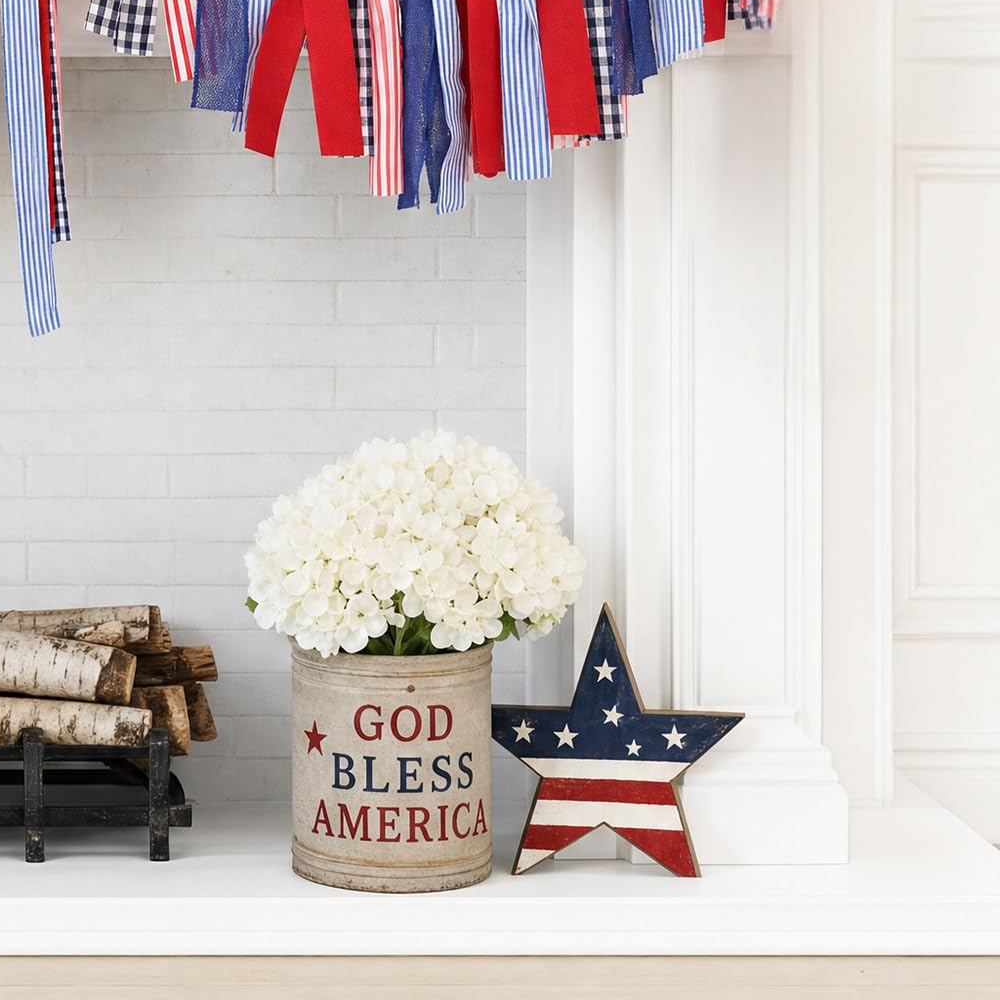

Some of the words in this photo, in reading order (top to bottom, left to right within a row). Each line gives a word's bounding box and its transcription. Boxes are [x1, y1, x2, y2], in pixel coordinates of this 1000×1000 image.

[353, 704, 454, 743] GOD
[331, 751, 474, 794] BLESS
[311, 798, 489, 844] AMERICA
